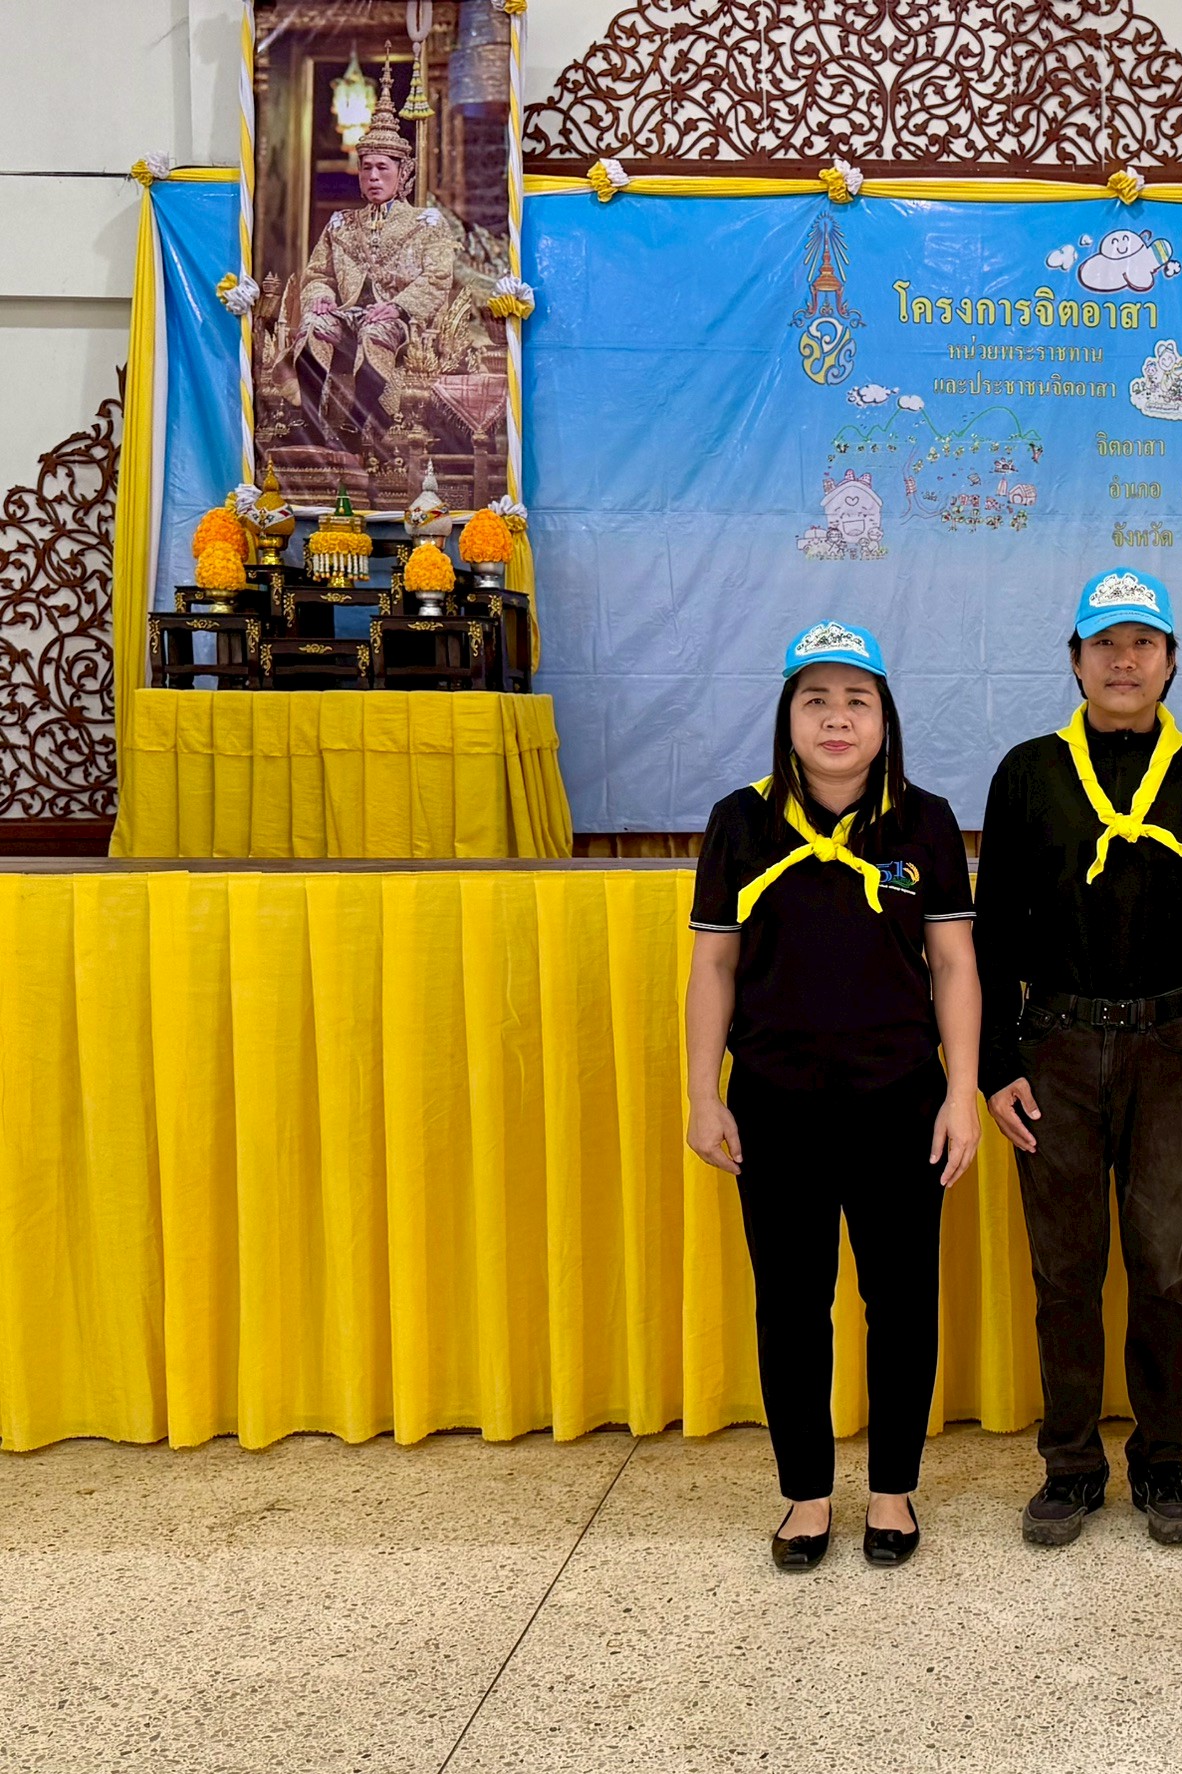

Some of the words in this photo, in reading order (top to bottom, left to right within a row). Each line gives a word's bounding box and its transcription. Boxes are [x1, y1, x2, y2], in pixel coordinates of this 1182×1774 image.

[892, 279, 1159, 330] โครงการจิตอาสา
[947, 335, 1104, 363] หน่วยพระราชทาน
[932, 371, 1117, 399] และประชาชนจิตอาสา
[1095, 430, 1166, 457] จิตอาสา
[1108, 474, 1162, 500] อำเภอ
[1112, 521, 1174, 548] จังหวัด
